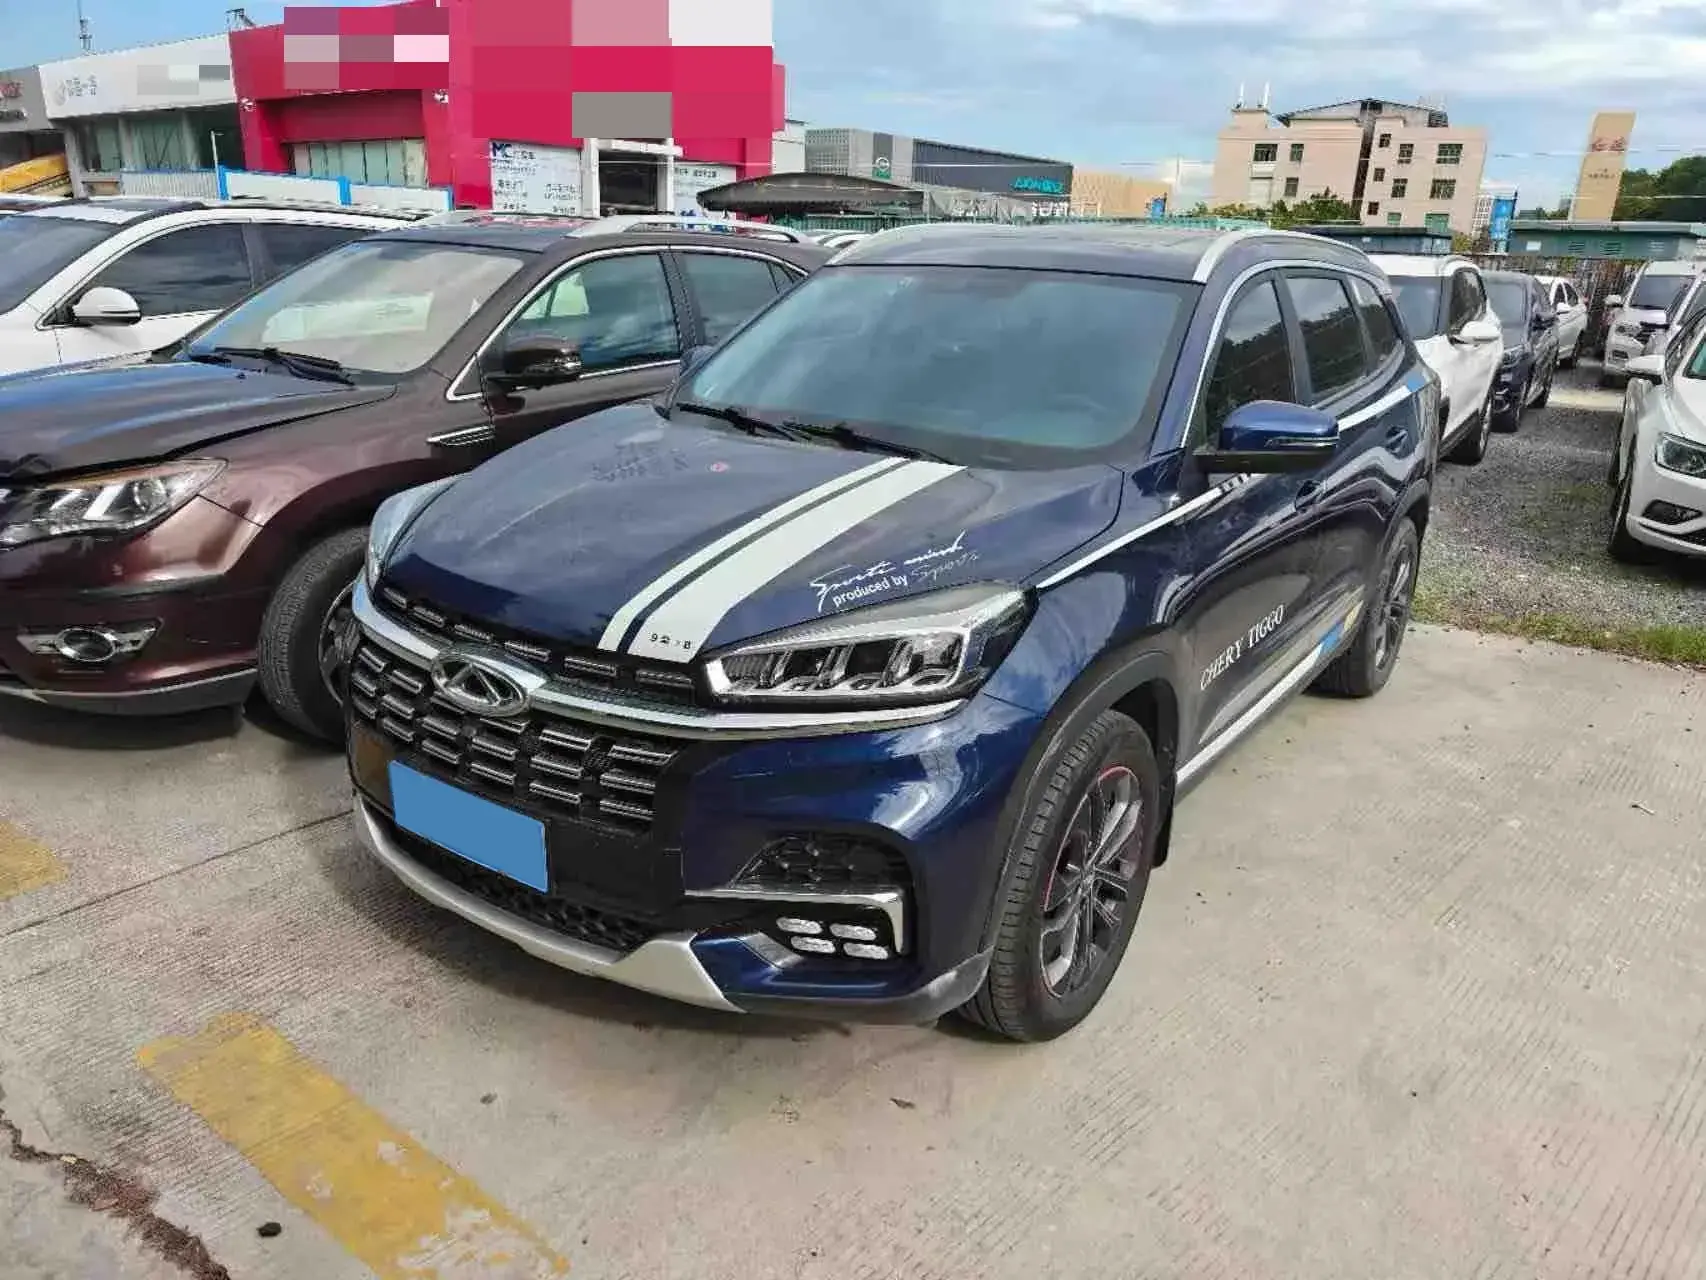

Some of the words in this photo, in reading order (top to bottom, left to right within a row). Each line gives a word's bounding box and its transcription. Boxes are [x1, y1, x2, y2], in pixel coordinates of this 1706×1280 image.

[832, 577, 891, 607] produced
[893, 574, 909, 587] by
[1200, 638, 1244, 691] CHERY
[1247, 604, 1284, 648] TIGGO
